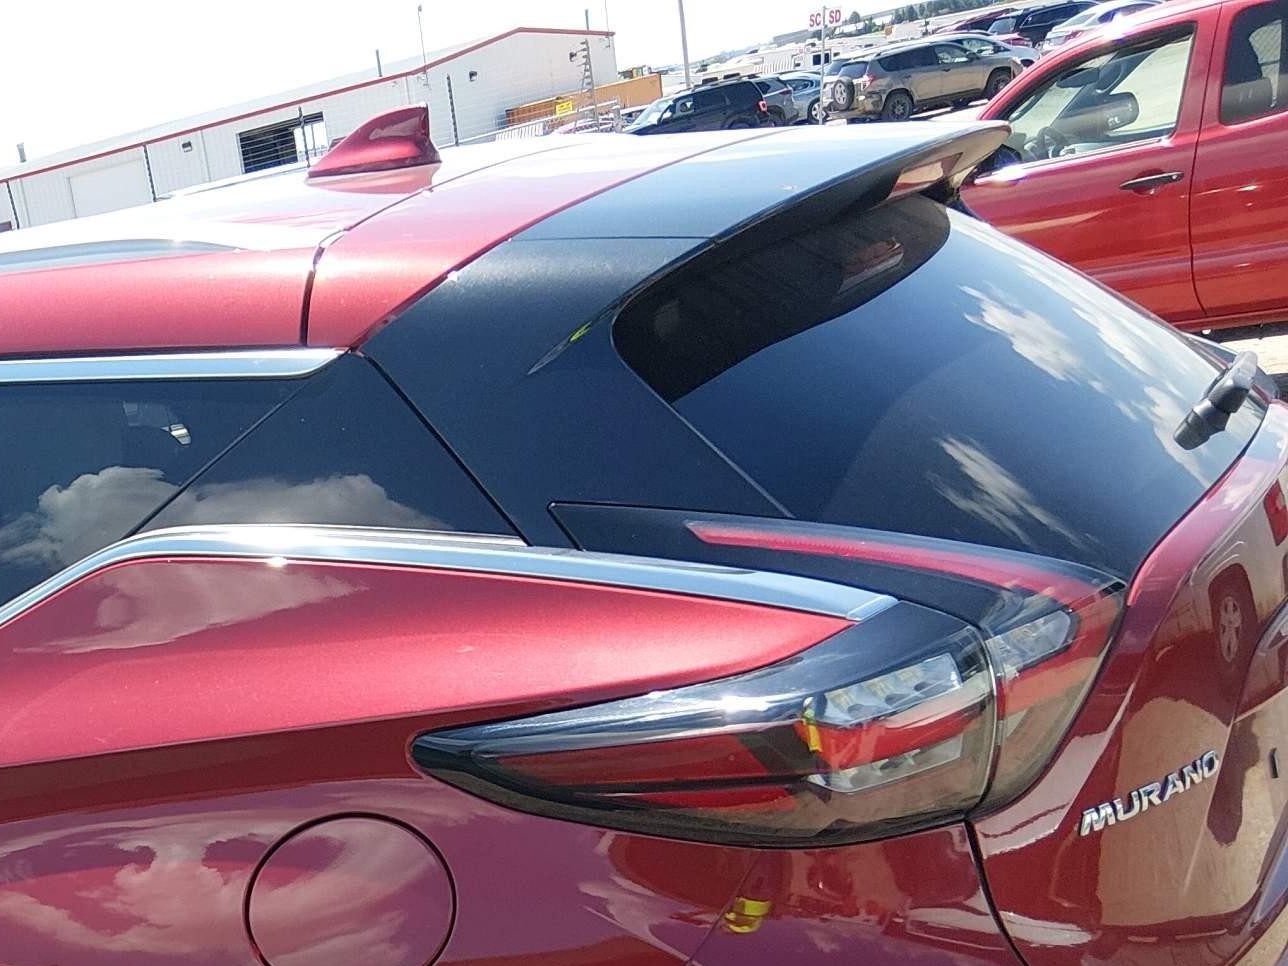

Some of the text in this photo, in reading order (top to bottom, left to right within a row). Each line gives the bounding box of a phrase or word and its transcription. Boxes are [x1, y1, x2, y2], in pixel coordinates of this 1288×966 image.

[809, 12, 821, 27] SC
[828, 9, 841, 24] SD
[1080, 750, 1220, 837] MURANO
